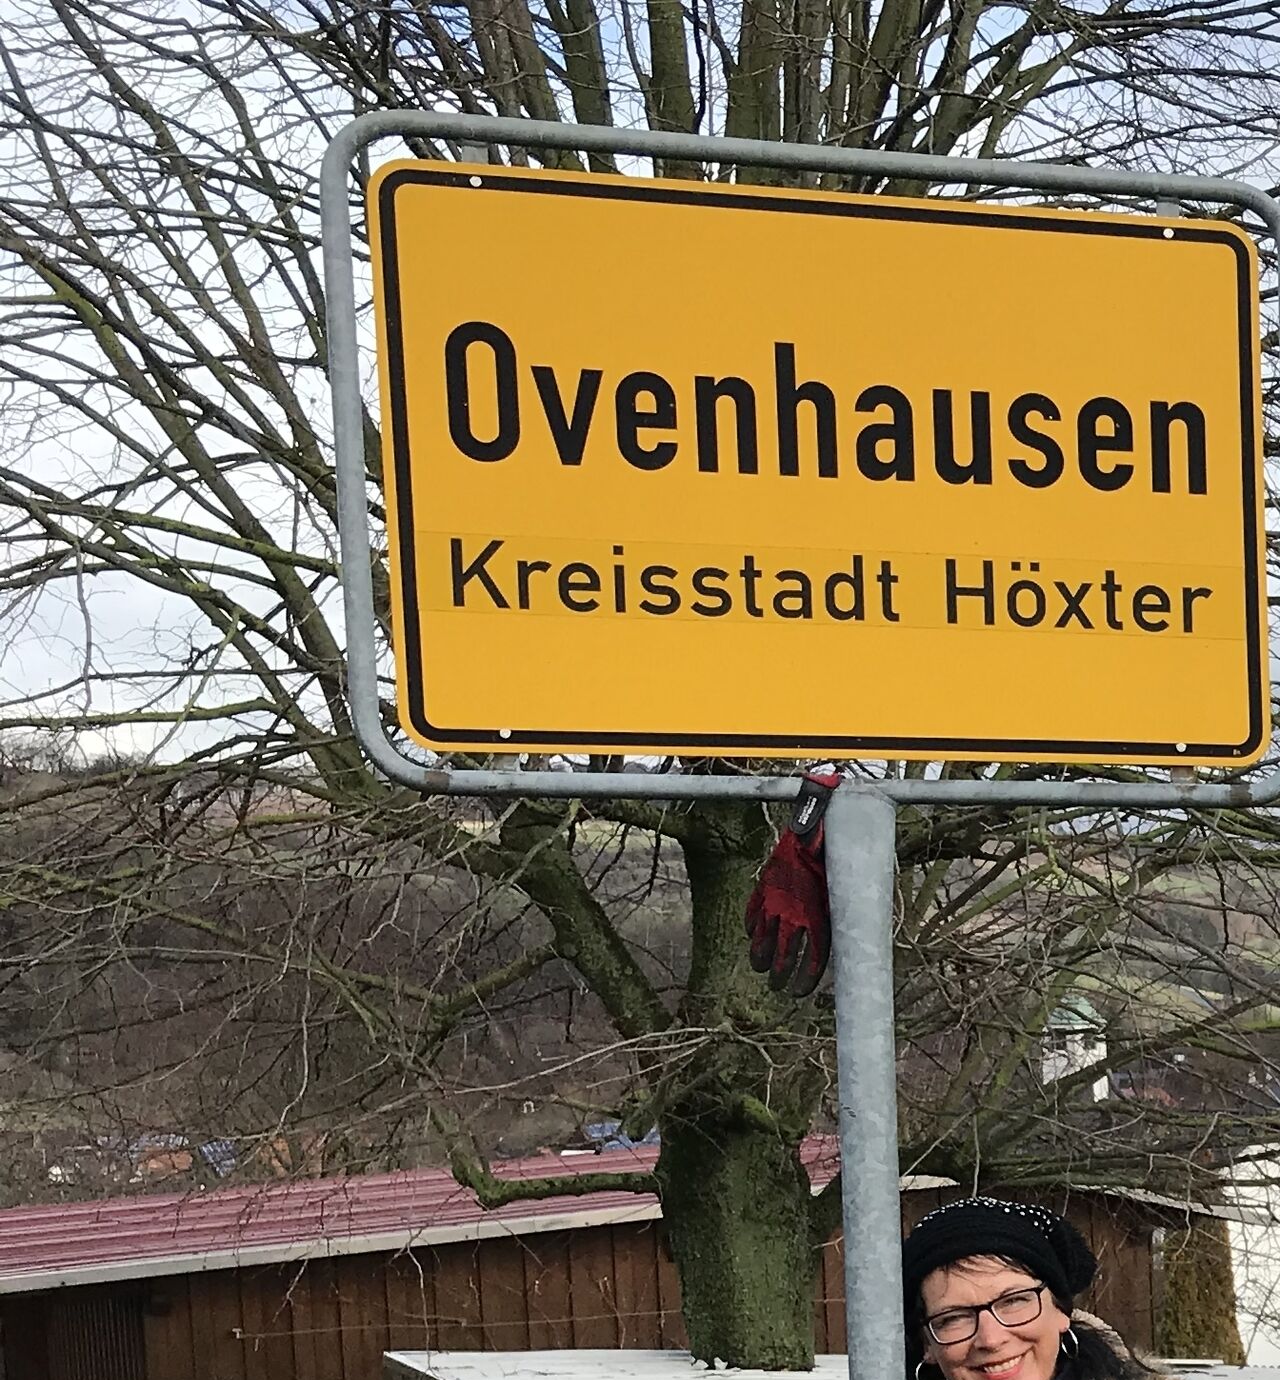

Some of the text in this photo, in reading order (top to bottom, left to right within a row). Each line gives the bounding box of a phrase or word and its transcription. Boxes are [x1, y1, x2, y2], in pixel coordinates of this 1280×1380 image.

[445, 322, 1208, 494] Ovenhausen
[450, 538, 1213, 634] Kreisstadt Höxter
